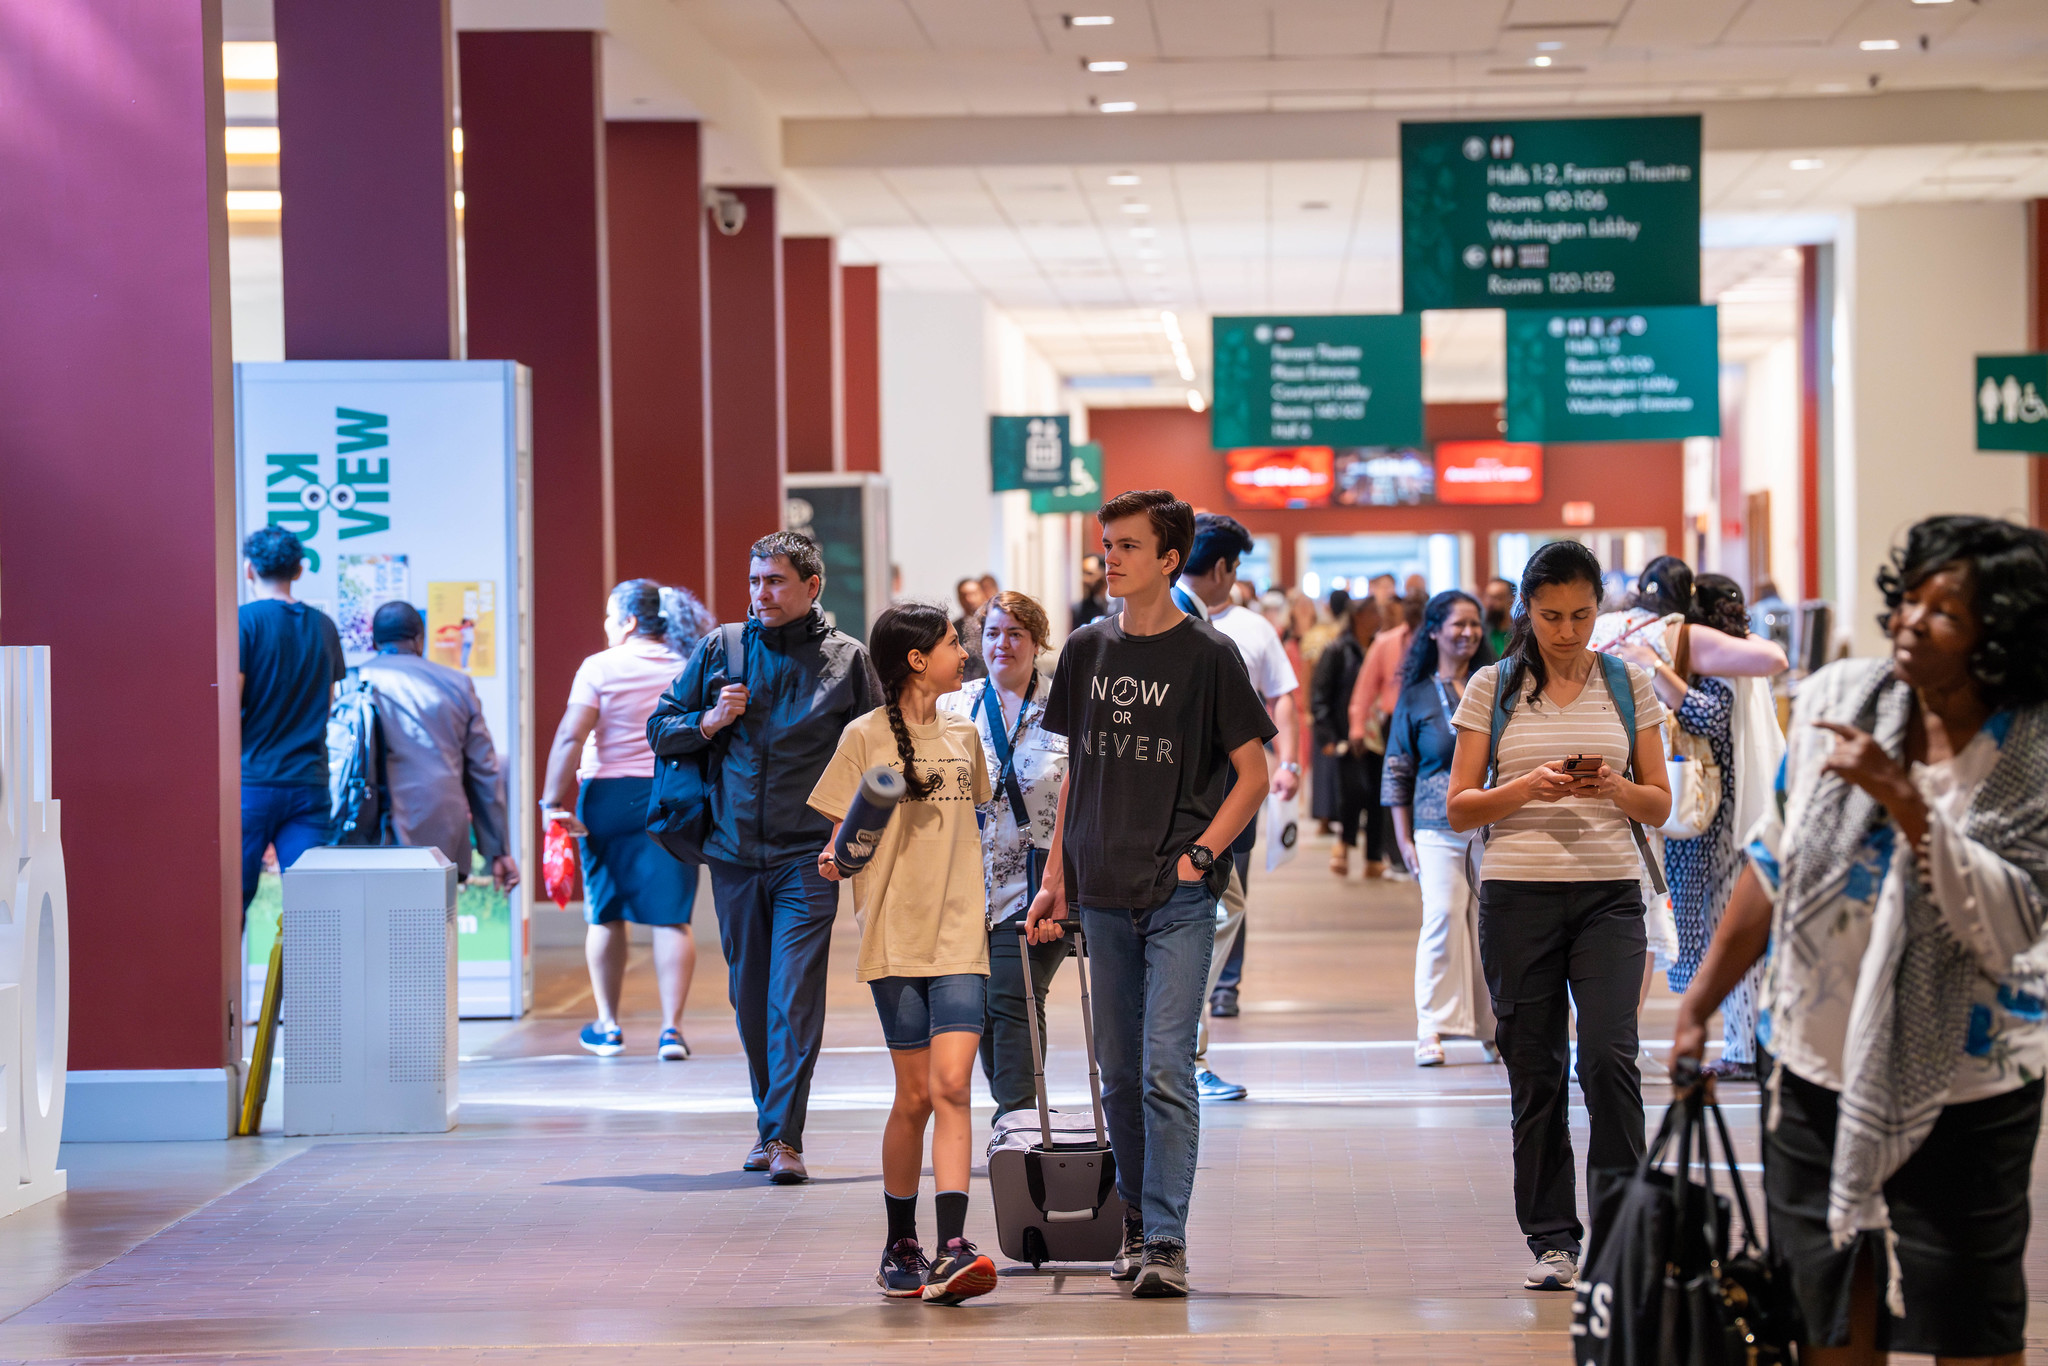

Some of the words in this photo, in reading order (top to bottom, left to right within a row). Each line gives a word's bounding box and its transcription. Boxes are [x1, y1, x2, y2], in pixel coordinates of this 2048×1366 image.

[1488, 166, 1529, 184] Halls
[1564, 163, 1625, 183] Ferrara
[1629, 161, 1690, 181] Theatre
[1488, 193, 1542, 212] Rooms
[1545, 190, 1607, 211] 90-106
[1488, 219, 1585, 243] Washington
[1589, 217, 1640, 240] Lobby
[1489, 275, 1543, 294] Rooms
[1548, 271, 1615, 293] 120-132
[1566, 377, 1638, 395] Washington
[1566, 397, 1638, 416] Washington
[336, 407, 390, 540] VIEW
[1091, 675, 1170, 707] NOW
[1112, 710, 1132, 725] OR
[1082, 731, 1174, 764] NEVER
